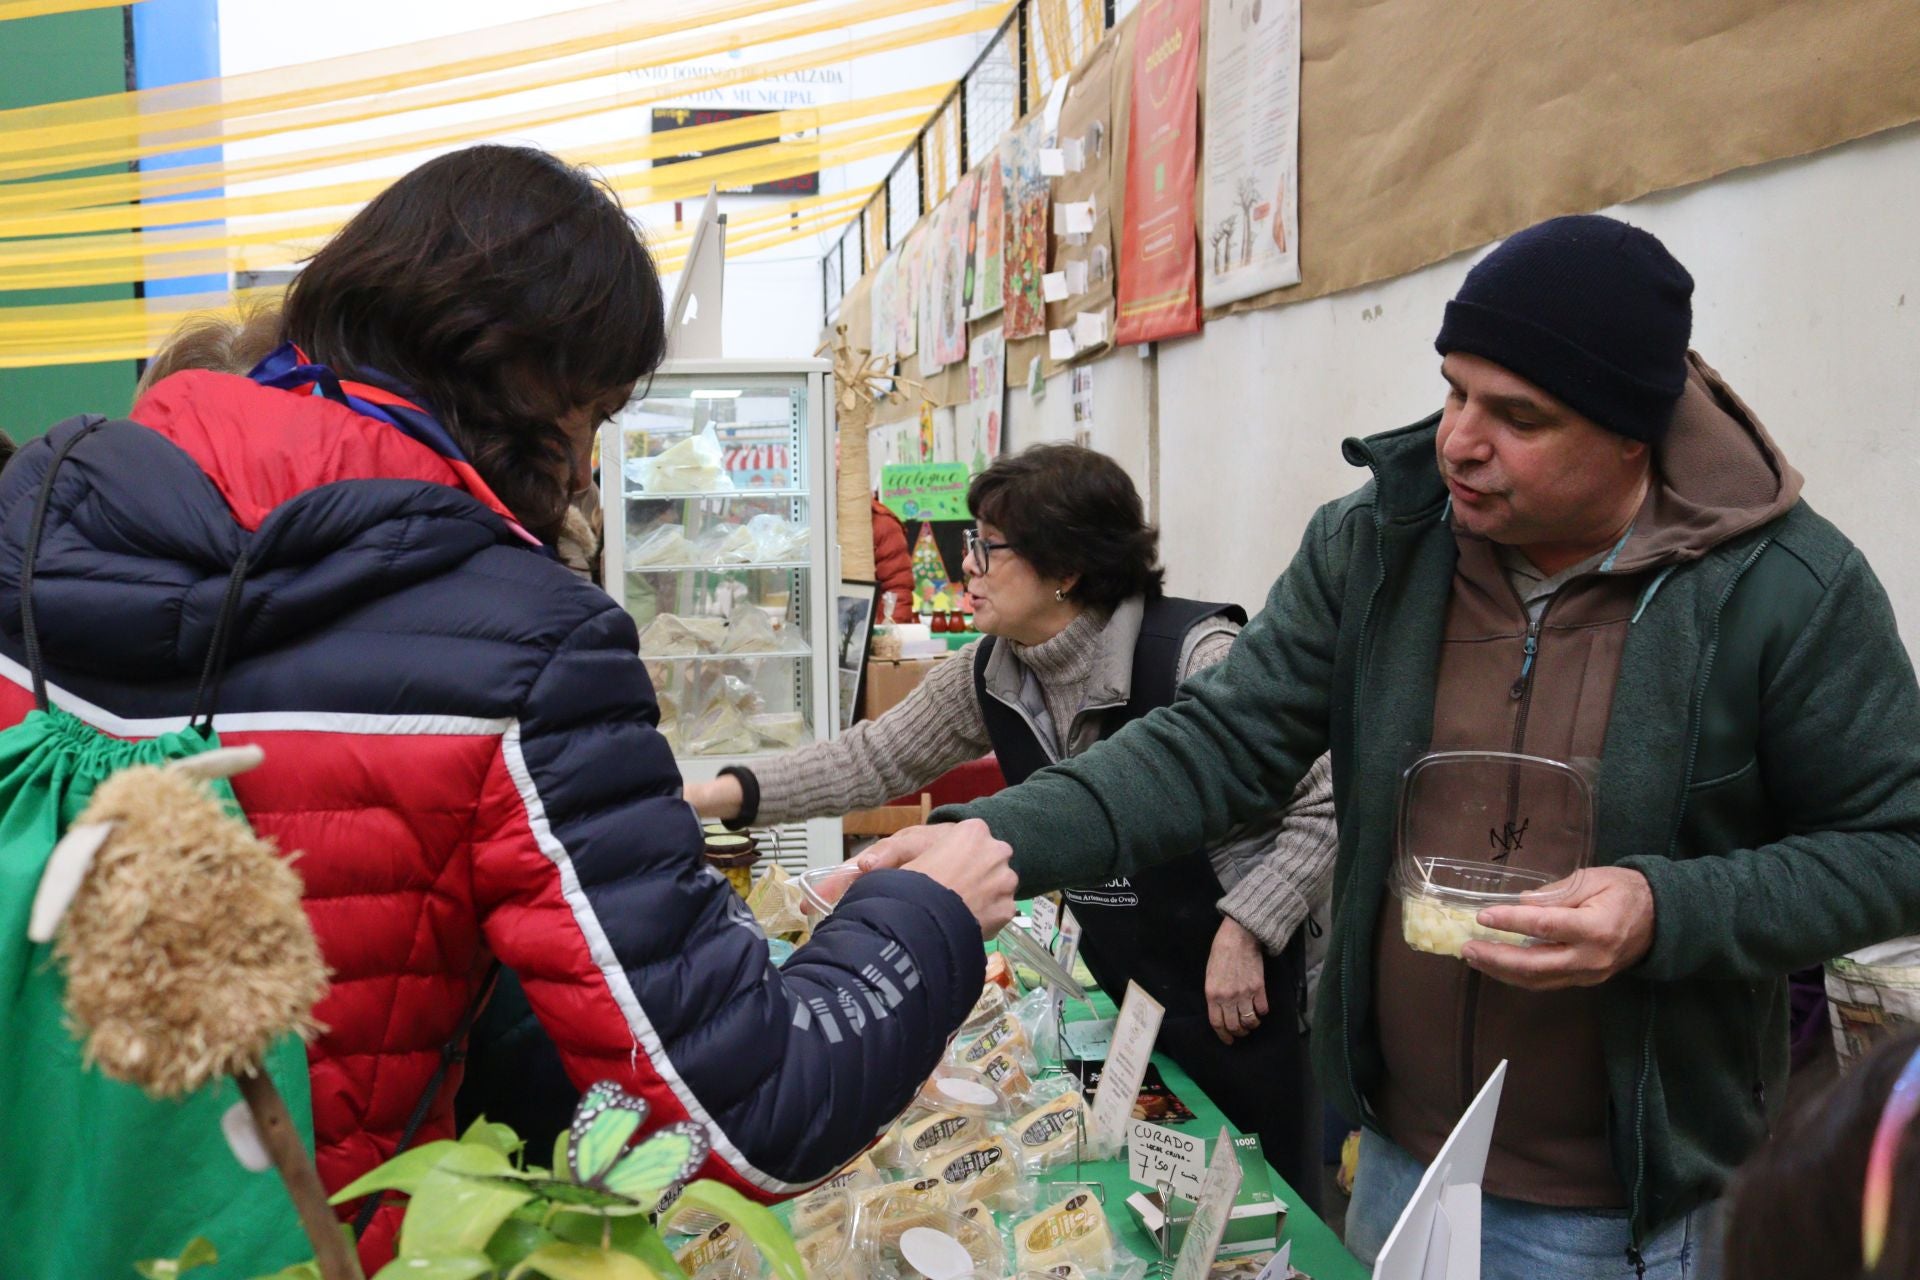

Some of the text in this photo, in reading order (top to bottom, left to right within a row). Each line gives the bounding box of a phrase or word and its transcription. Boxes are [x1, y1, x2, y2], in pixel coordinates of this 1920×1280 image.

[783, 69, 843, 84] CALZADA
[732, 88, 816, 105] MUNICIPAL
[1135, 1125, 1194, 1152] CURADO
[1234, 1137, 1256, 1147] 1000
